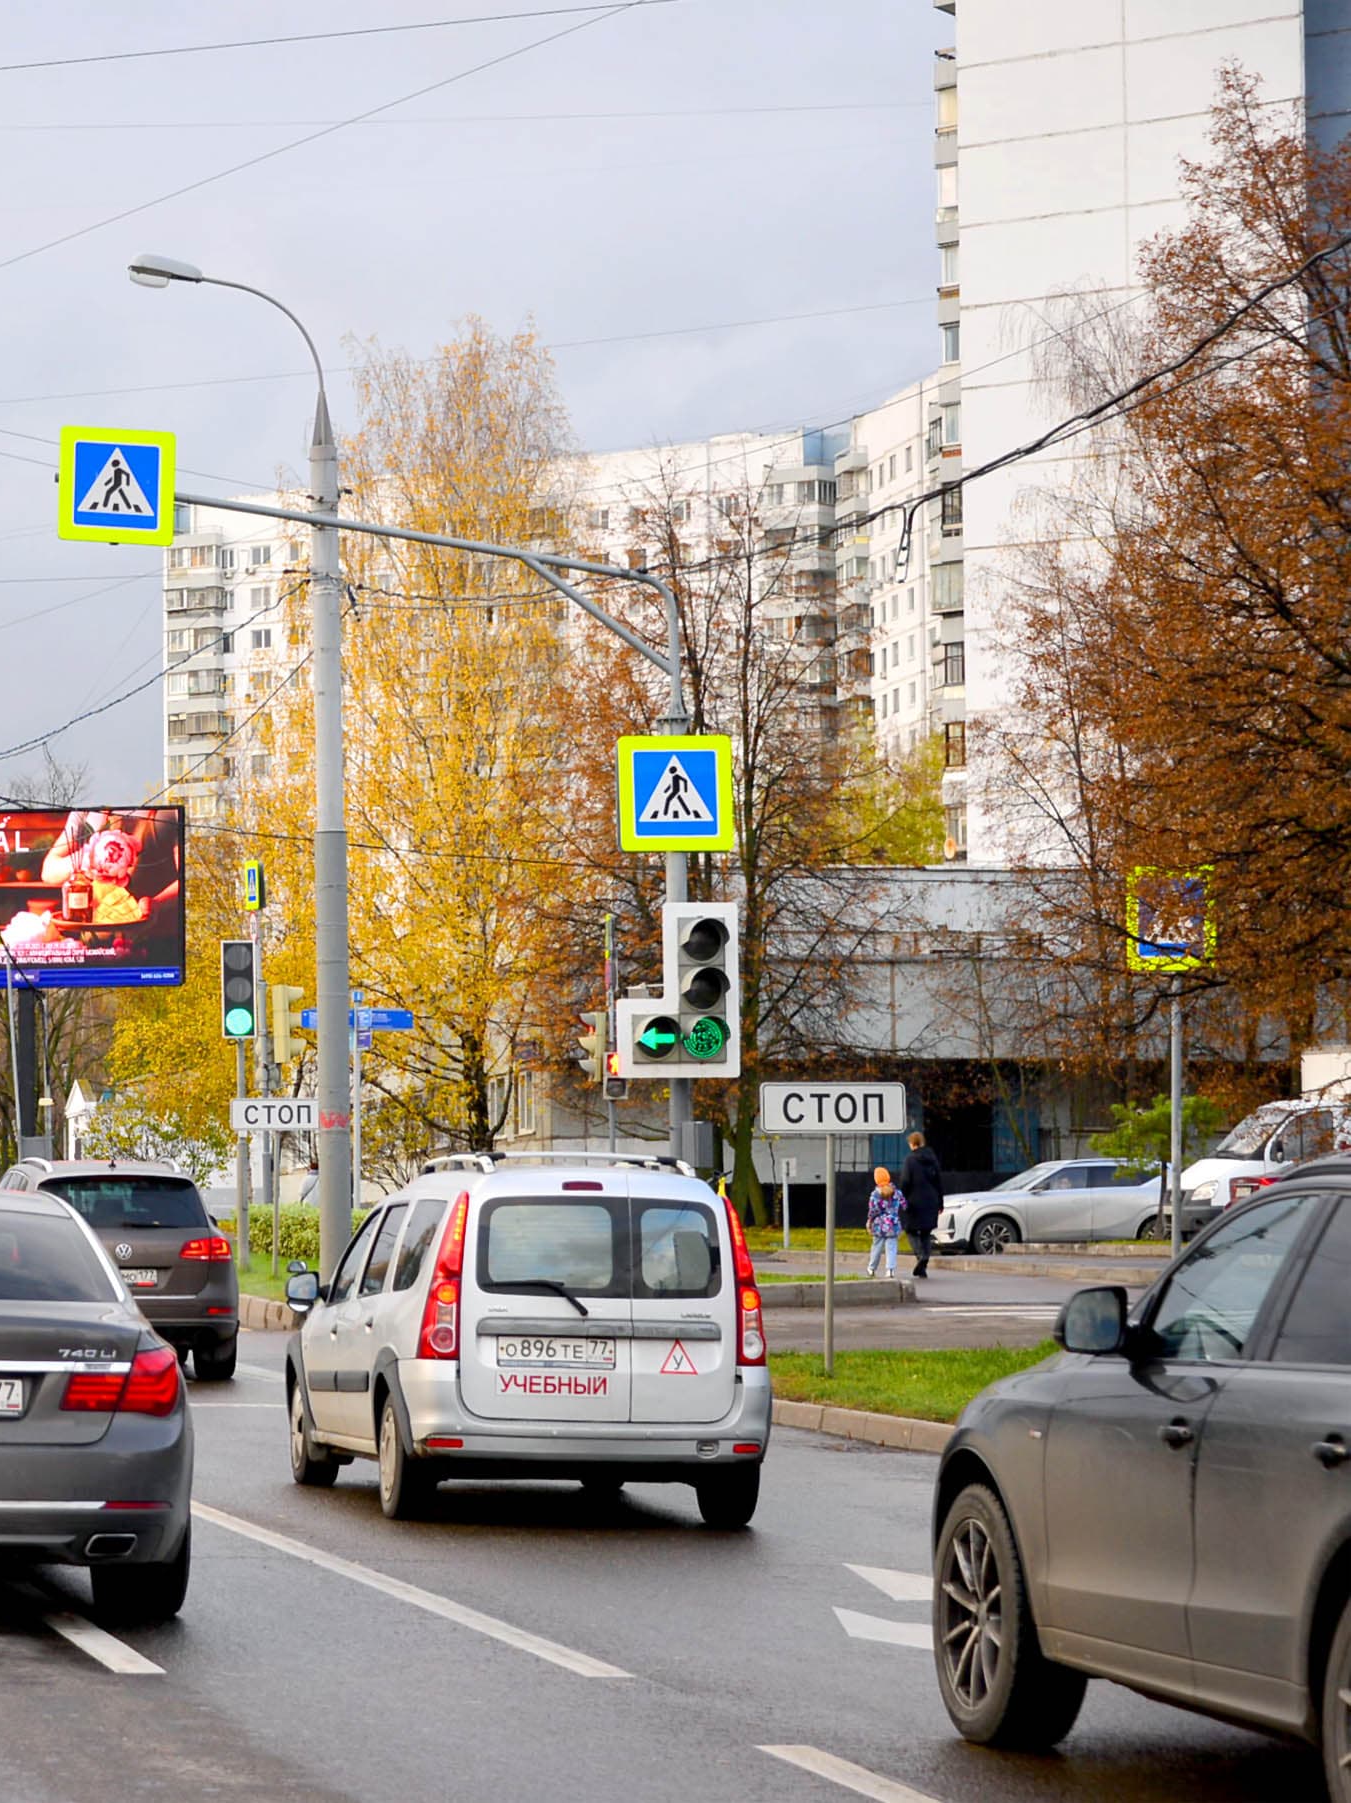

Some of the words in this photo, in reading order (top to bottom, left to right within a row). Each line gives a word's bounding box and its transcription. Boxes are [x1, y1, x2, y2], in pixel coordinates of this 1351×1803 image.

[244, 1104, 312, 1125] СТОП
[782, 1092, 884, 1124] СТОП
[58, 1348, 97, 1358] 740
[589, 1340, 608, 1355] 77
[499, 1374, 608, 1396] УЧЕБНЫЙ
